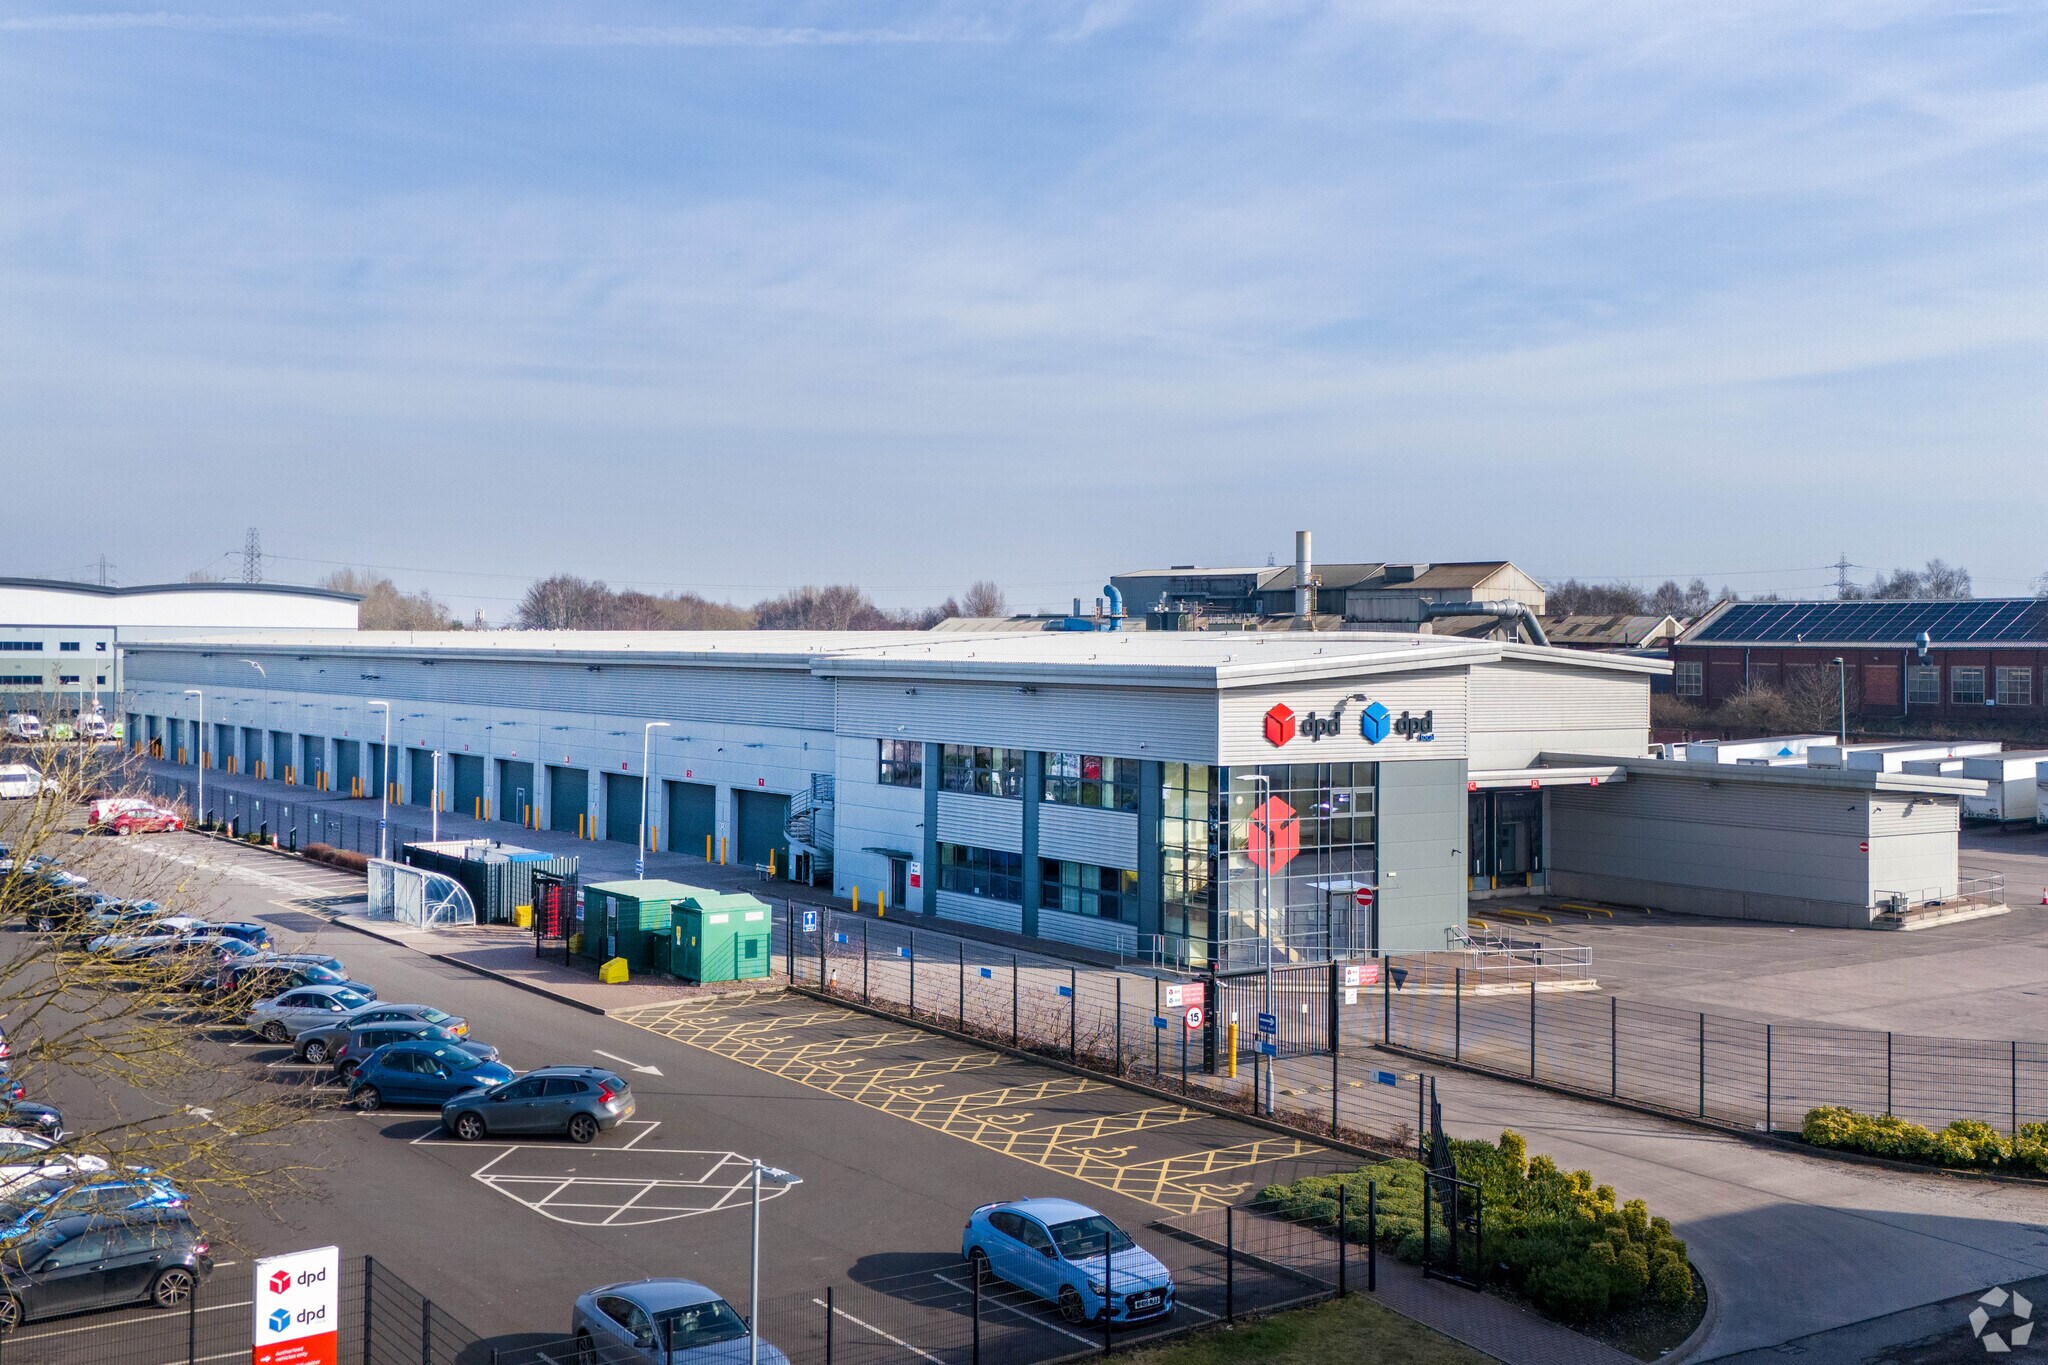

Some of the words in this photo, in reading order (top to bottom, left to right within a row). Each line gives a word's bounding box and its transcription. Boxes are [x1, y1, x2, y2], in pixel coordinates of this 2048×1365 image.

[1303, 711, 1341, 742] dpd
[1397, 710, 1433, 740] dpd
[1419, 733, 1434, 742] local
[1190, 1012, 1199, 1022] 15
[297, 1267, 326, 1287] dpd
[296, 1304, 325, 1325] dpd
